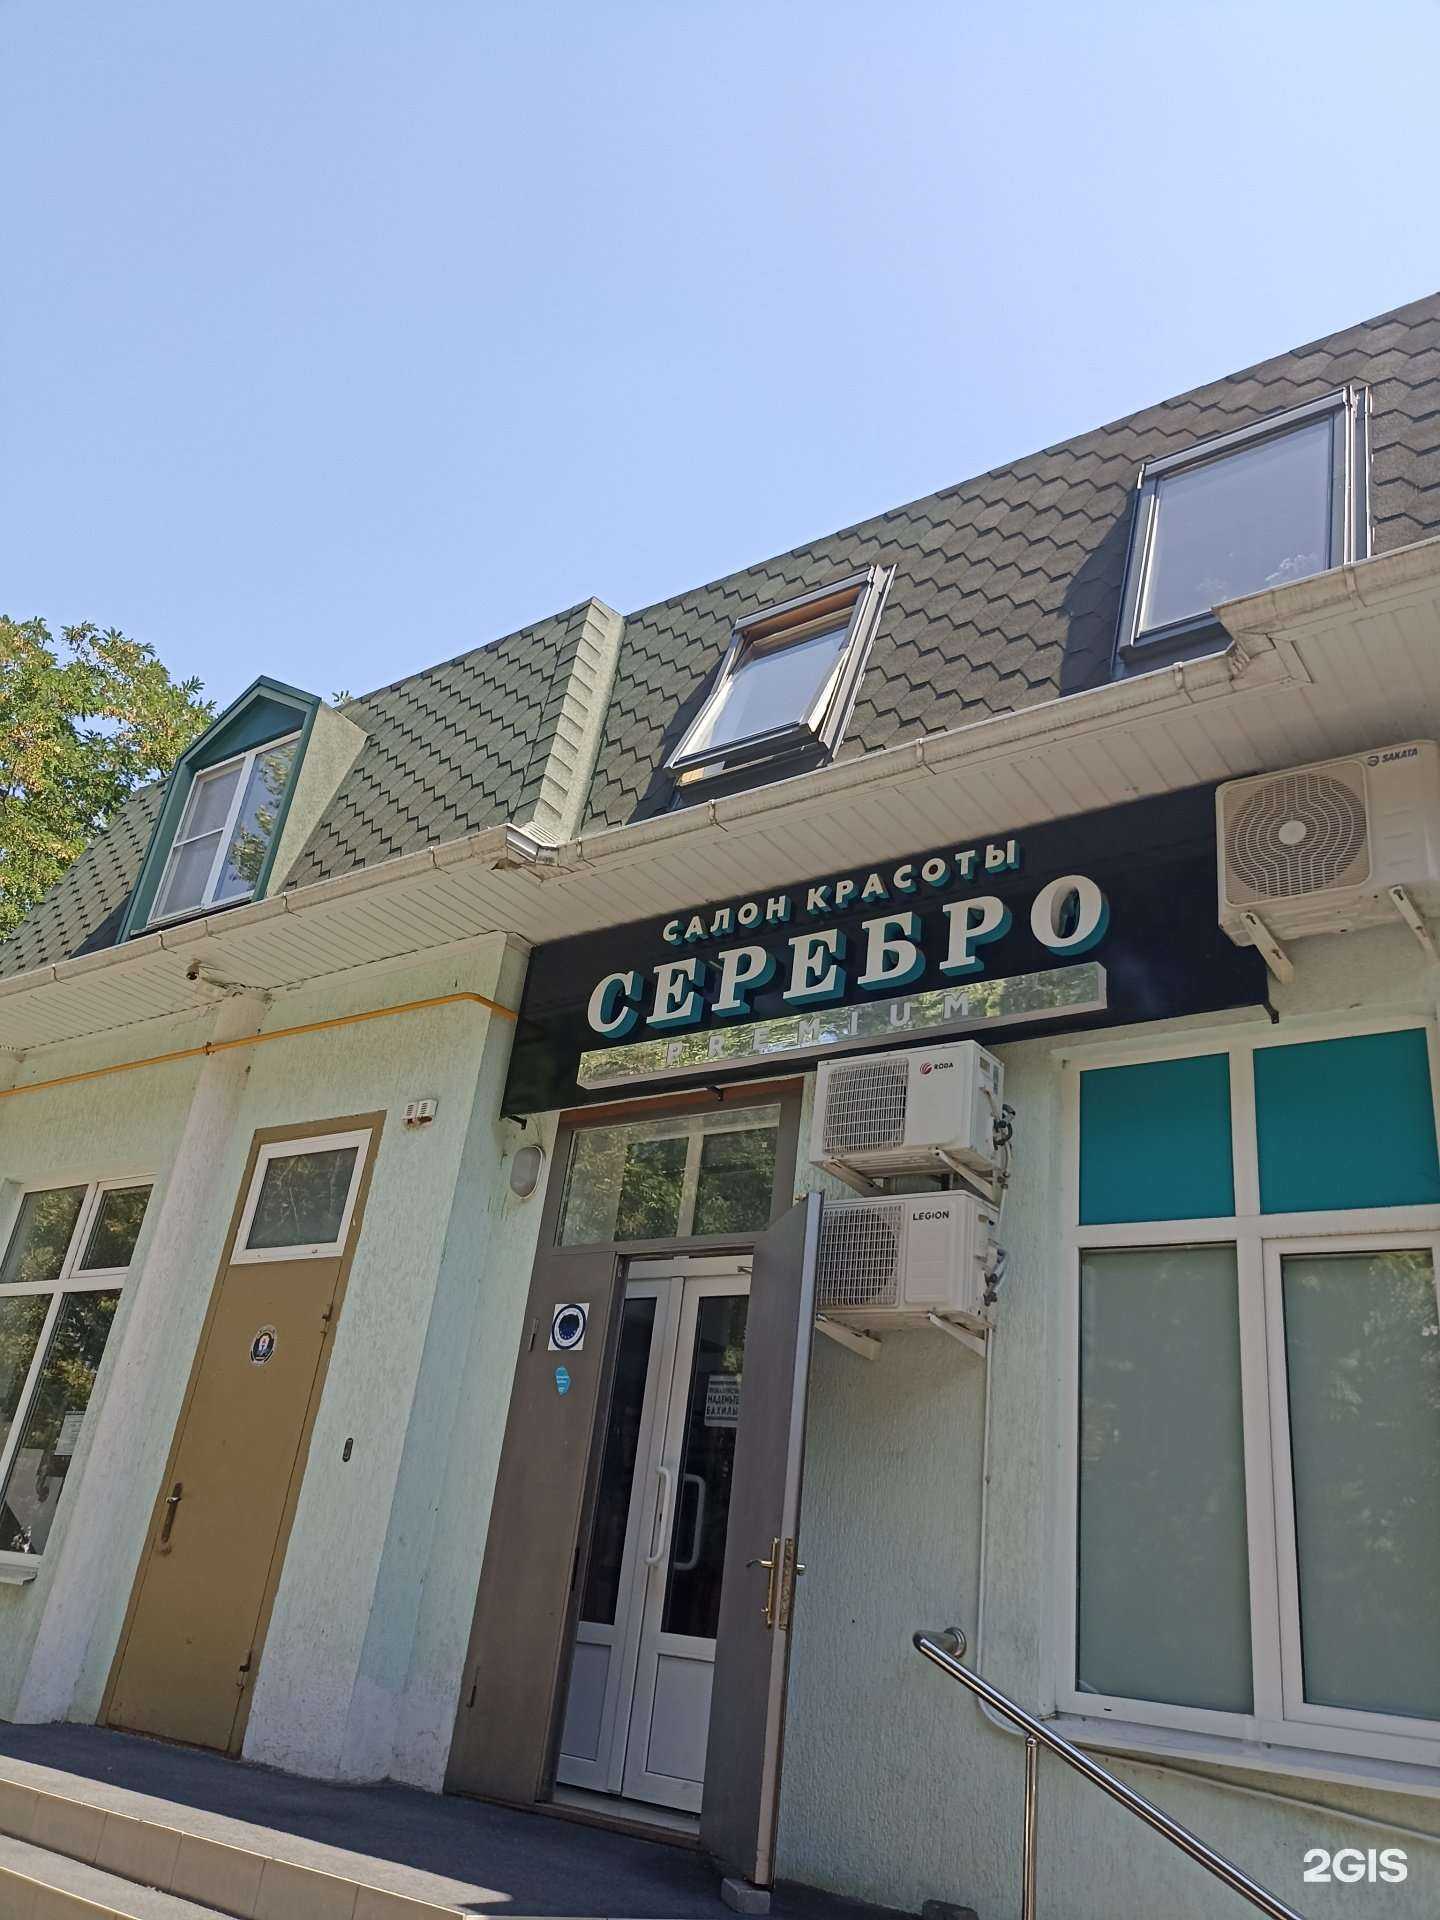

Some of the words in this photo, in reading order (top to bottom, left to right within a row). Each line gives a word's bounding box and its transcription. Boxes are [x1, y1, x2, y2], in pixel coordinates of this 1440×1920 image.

[1381, 747, 1418, 762] SAKATA
[662, 894, 789, 944] САЛОН
[807, 840, 1018, 913] КРАСОТЫ
[587, 874, 1107, 1037] СЕРЕБРО
[666, 992, 969, 1066] PREMIUM
[933, 1061, 954, 1071] RODA
[912, 1210, 950, 1222] LEGION
